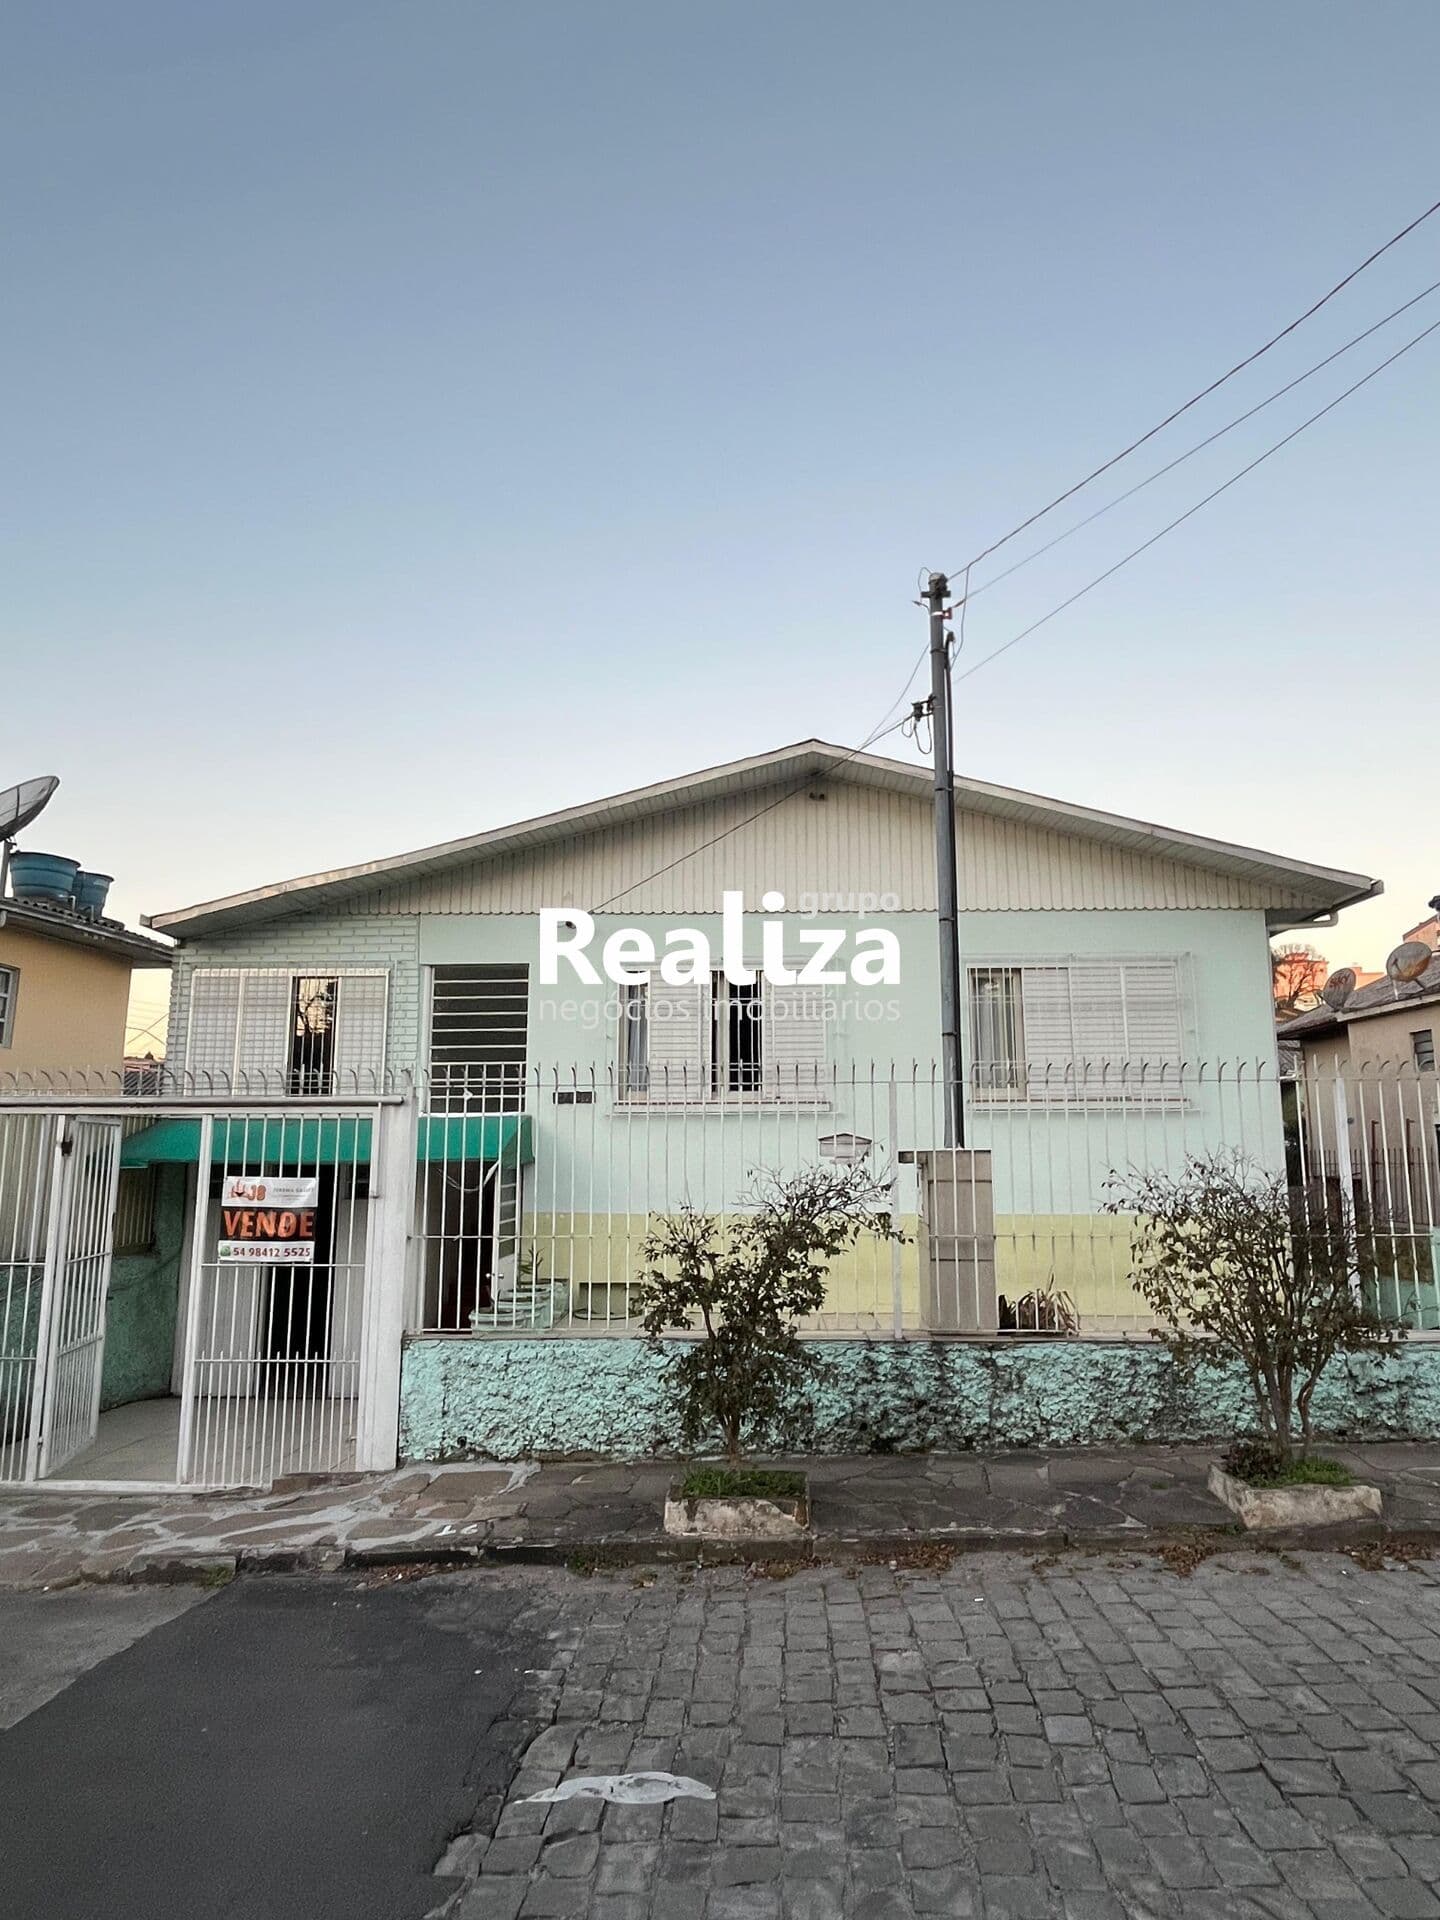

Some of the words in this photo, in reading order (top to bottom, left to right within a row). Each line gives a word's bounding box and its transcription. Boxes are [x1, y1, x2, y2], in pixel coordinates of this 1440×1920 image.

[223, 1210, 315, 1238] VENDE
[233, 1247, 245, 1257] 54
[249, 1247, 280, 1258] 98412
[284, 1247, 311, 1257] 5525
